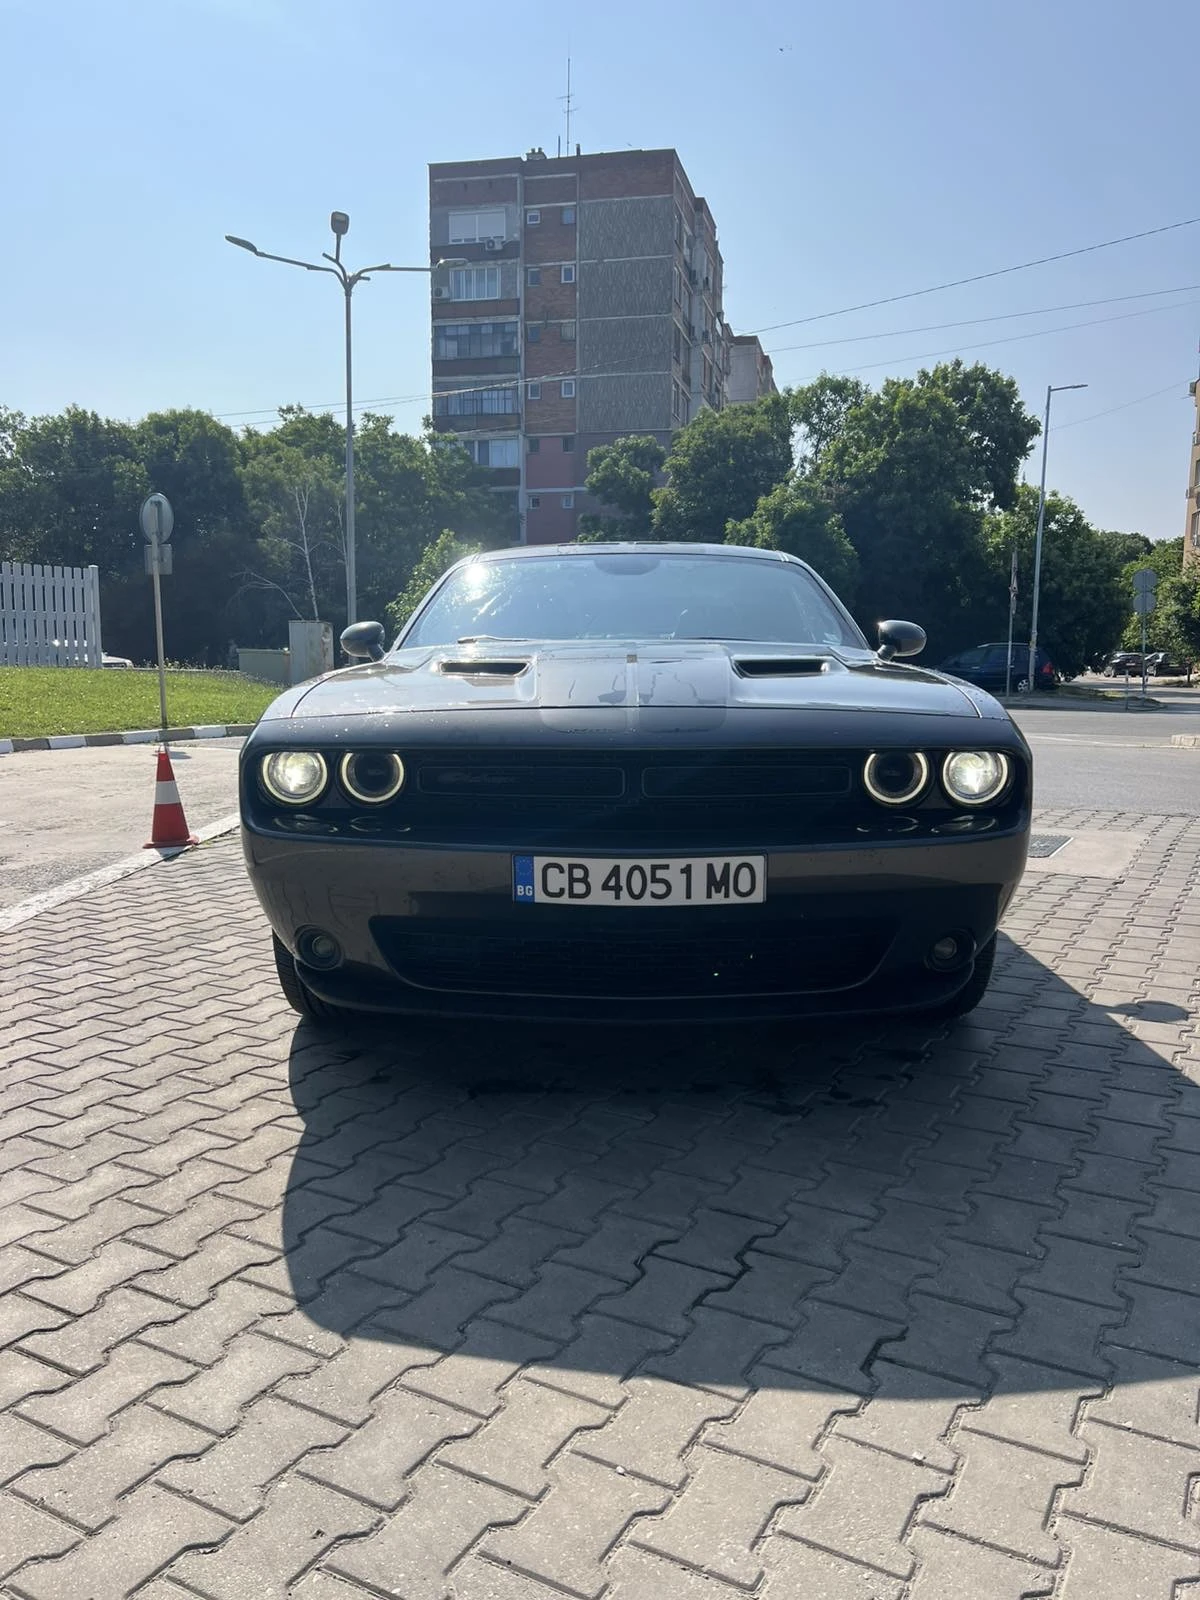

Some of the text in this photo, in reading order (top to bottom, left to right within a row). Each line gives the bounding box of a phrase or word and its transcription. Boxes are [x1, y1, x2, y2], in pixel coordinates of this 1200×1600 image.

[517, 885, 533, 896] BG
[541, 862, 757, 900] CB 4051 MO
